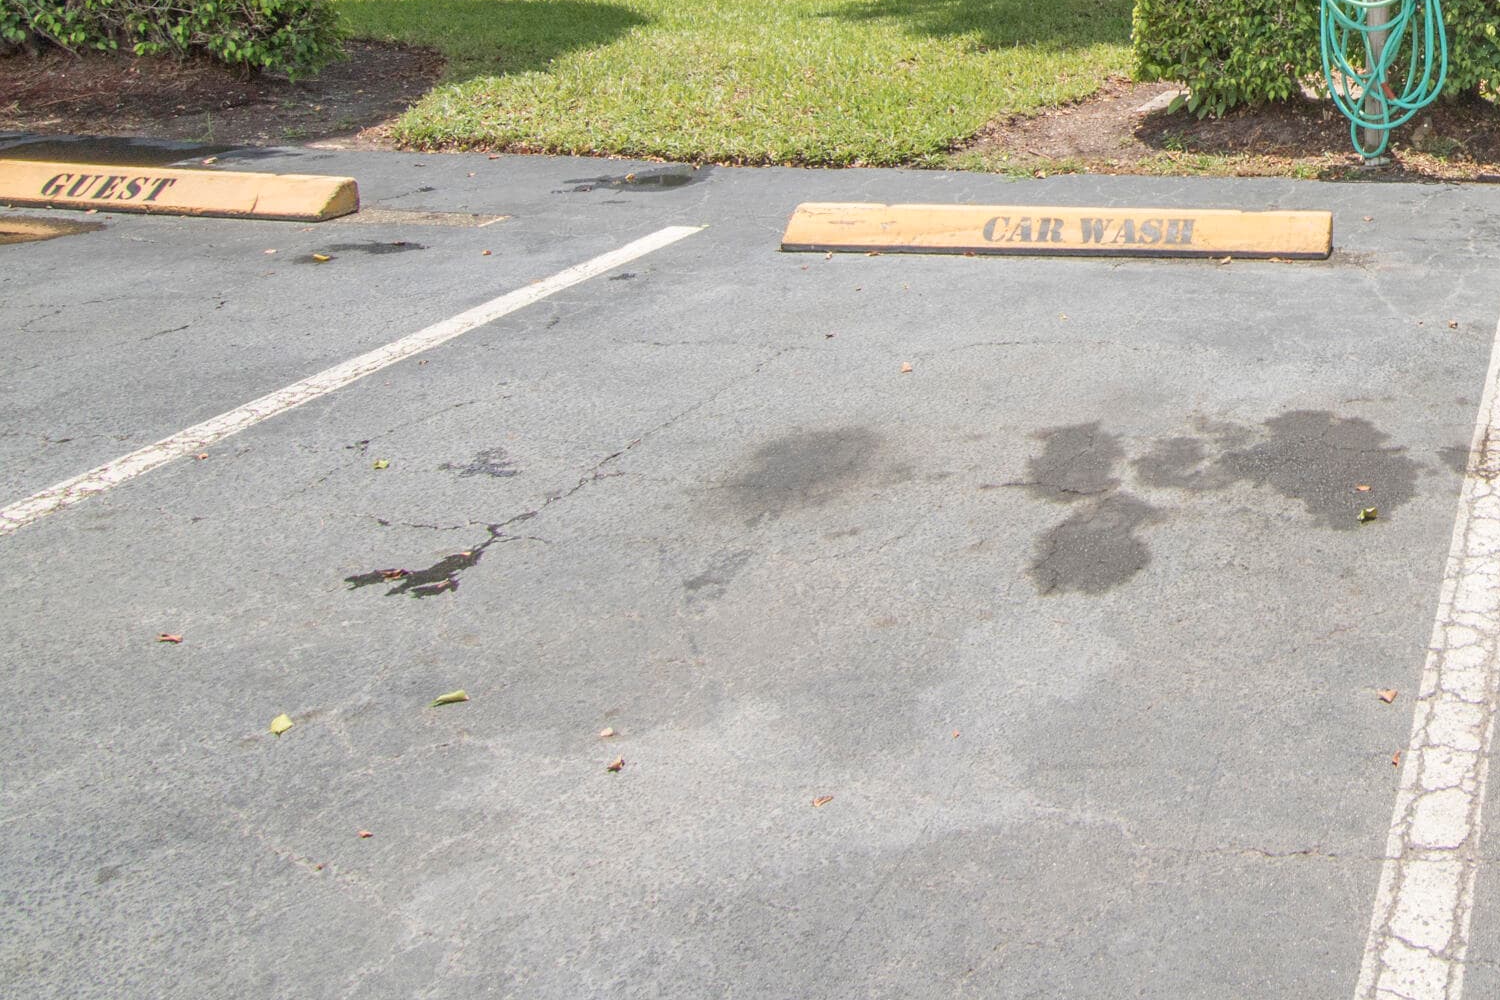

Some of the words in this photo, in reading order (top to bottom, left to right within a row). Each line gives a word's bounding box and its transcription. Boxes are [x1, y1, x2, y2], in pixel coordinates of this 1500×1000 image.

[40, 172, 178, 202] GUEST
[982, 215, 1067, 244] CAR
[1079, 216, 1196, 246] WASH
